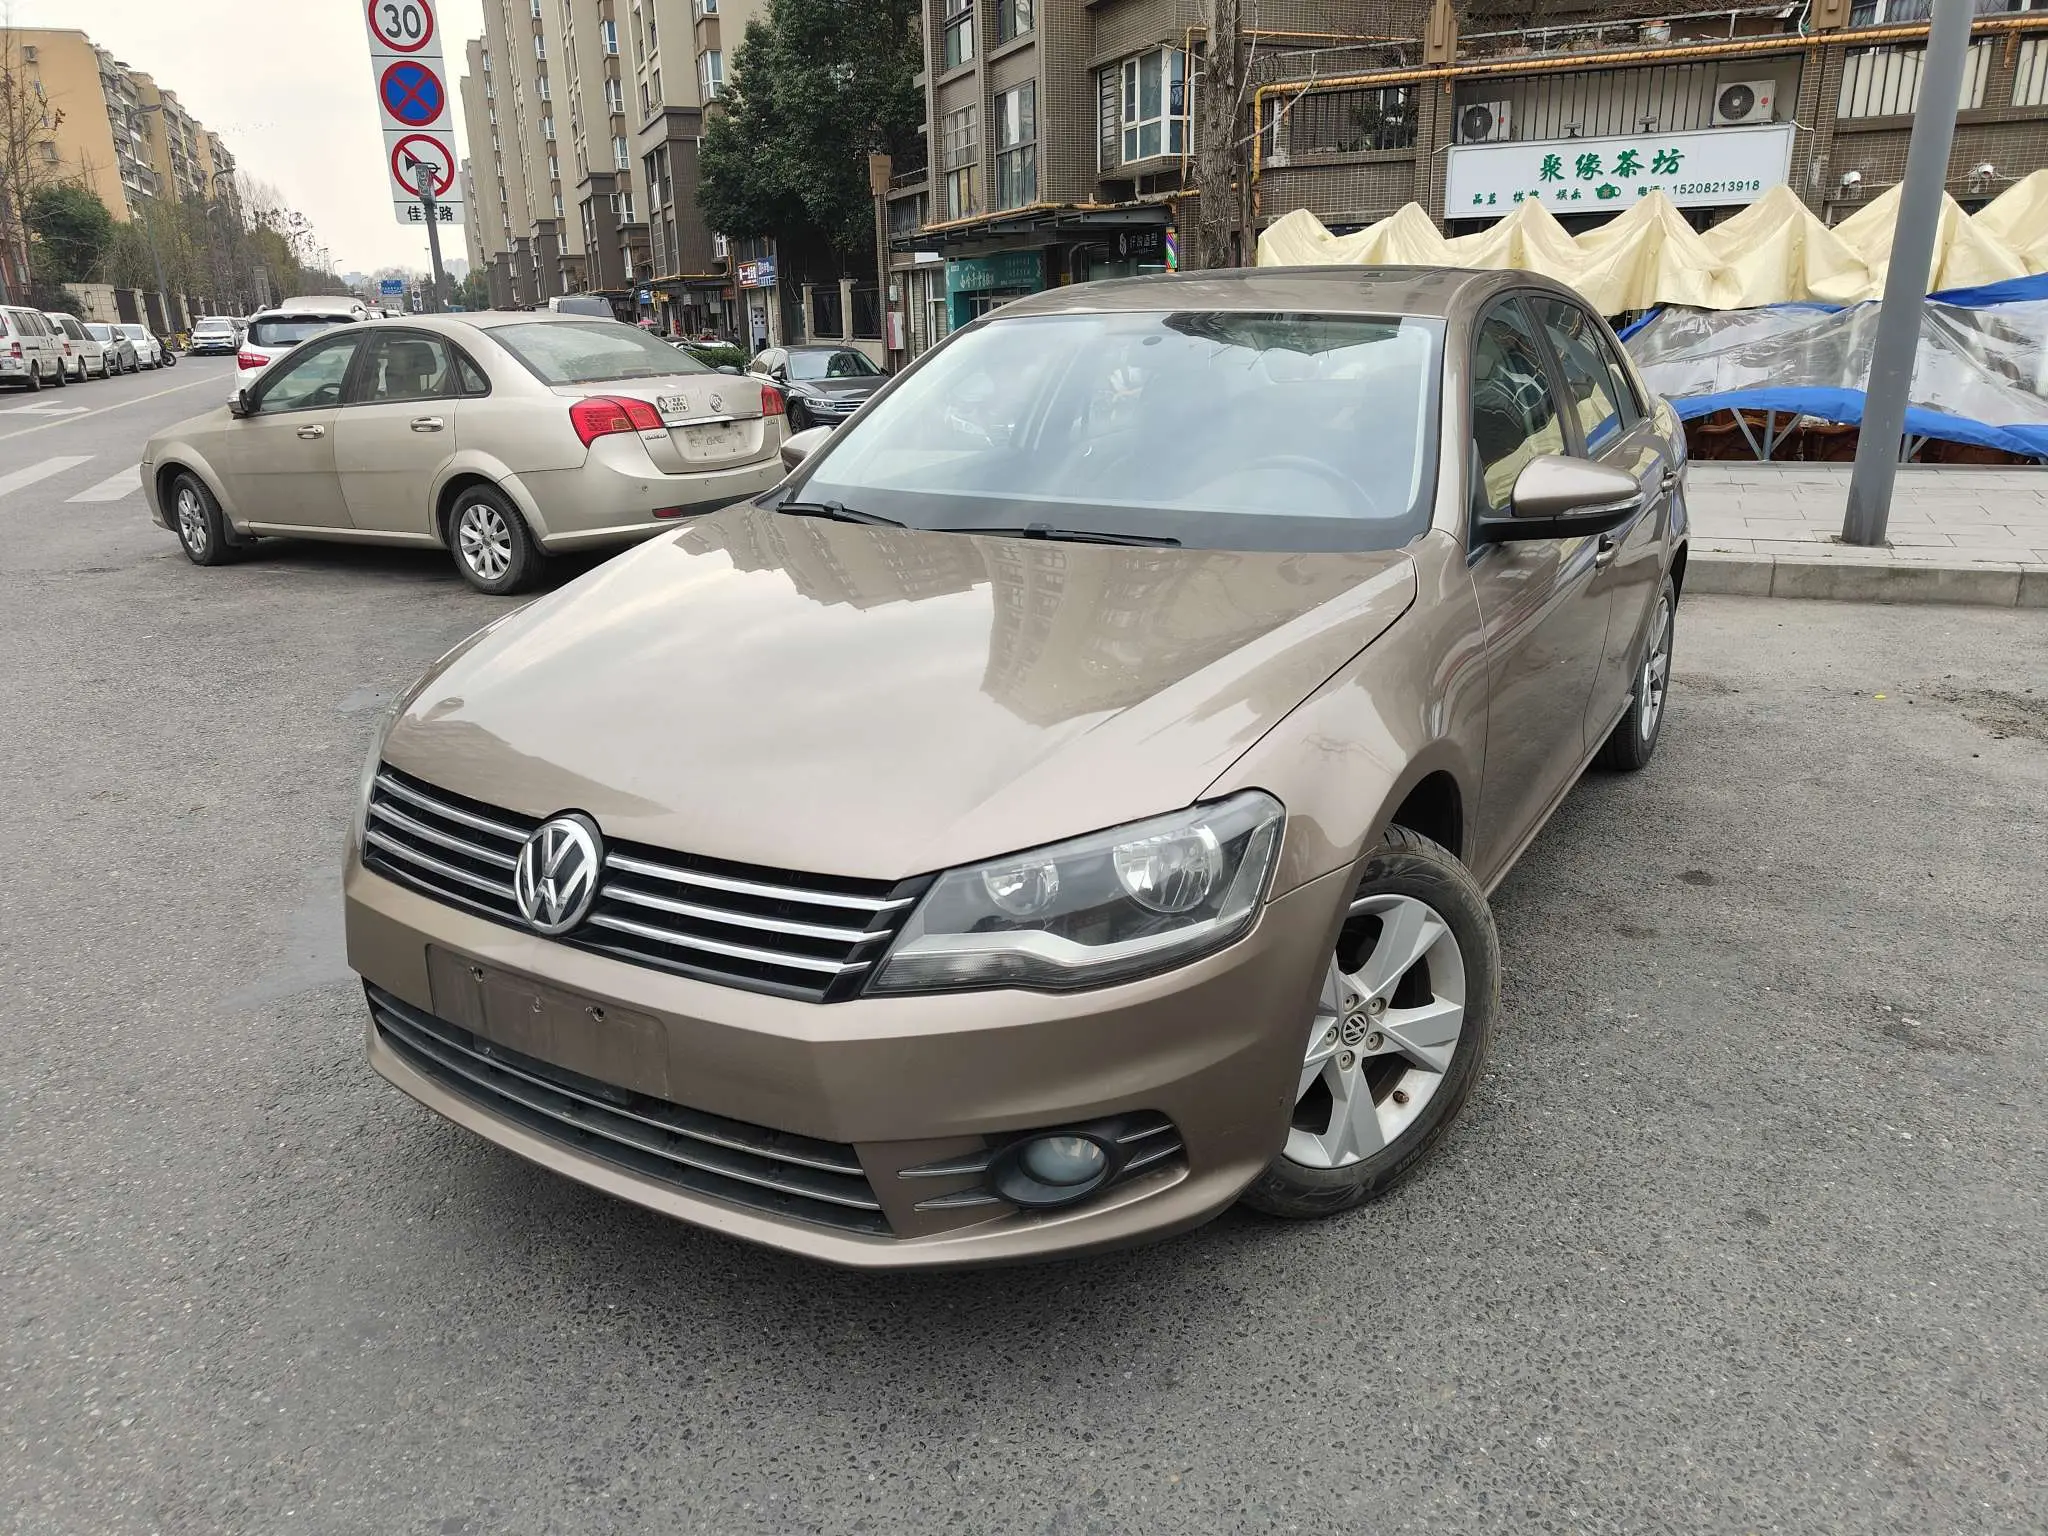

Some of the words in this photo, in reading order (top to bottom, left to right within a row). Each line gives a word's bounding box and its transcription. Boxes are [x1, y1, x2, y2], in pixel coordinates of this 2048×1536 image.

[383, 4, 421, 38] 30
[1539, 149, 1685, 182] 聚缘茶坊
[1472, 192, 1496, 205] 品茗
[1556, 188, 1582, 200] 娱乐
[1672, 180, 1760, 195] 15208213918
